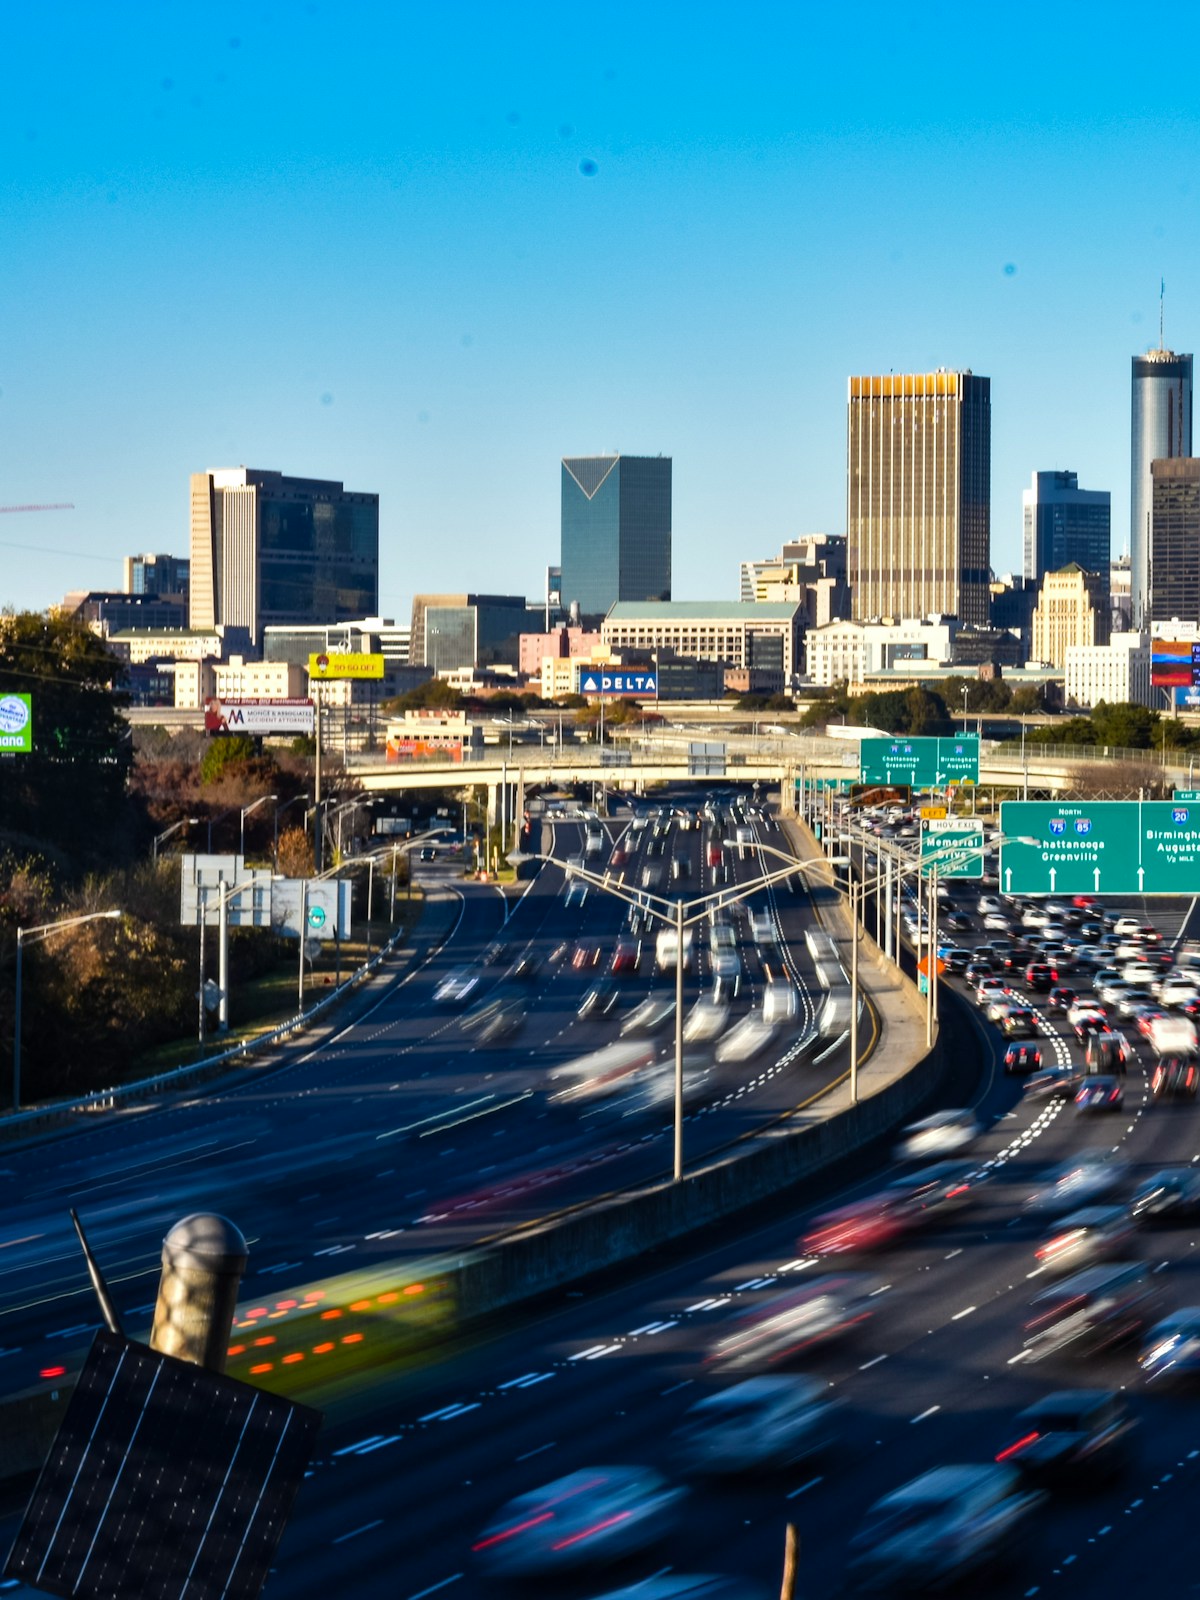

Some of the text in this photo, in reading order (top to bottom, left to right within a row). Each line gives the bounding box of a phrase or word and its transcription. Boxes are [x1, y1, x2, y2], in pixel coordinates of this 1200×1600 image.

[602, 677, 656, 689] DELTA
[0, 736, 24, 746] ana
[1058, 808, 1082, 816] NORTH
[1175, 813, 1187, 822] 20
[1052, 824, 1089, 833] 75 85
[926, 838, 978, 847] Memorial
[1036, 840, 1105, 850] hattanooga
[1041, 852, 1098, 861] Greenville
